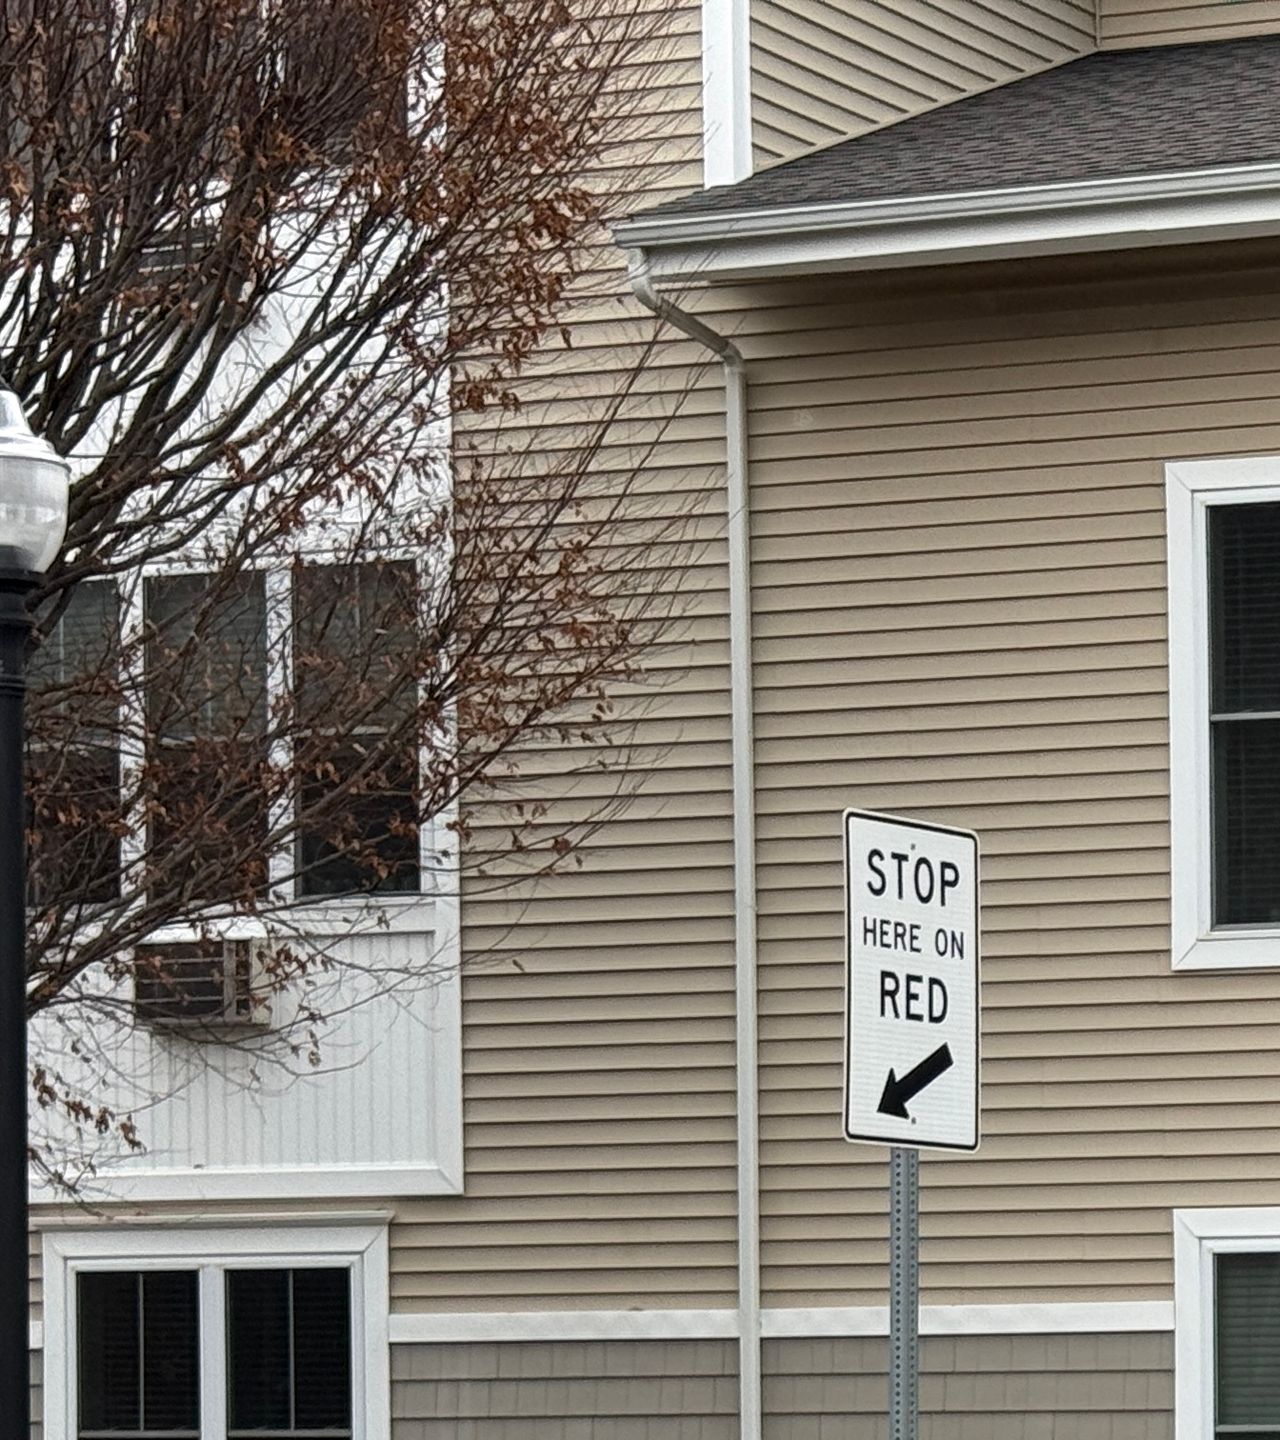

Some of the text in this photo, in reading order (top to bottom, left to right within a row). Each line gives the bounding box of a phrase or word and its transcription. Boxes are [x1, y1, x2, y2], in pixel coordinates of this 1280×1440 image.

[867, 848, 960, 907] STOP
[862, 916, 965, 960] HERE ON
[879, 969, 949, 1024] RED
